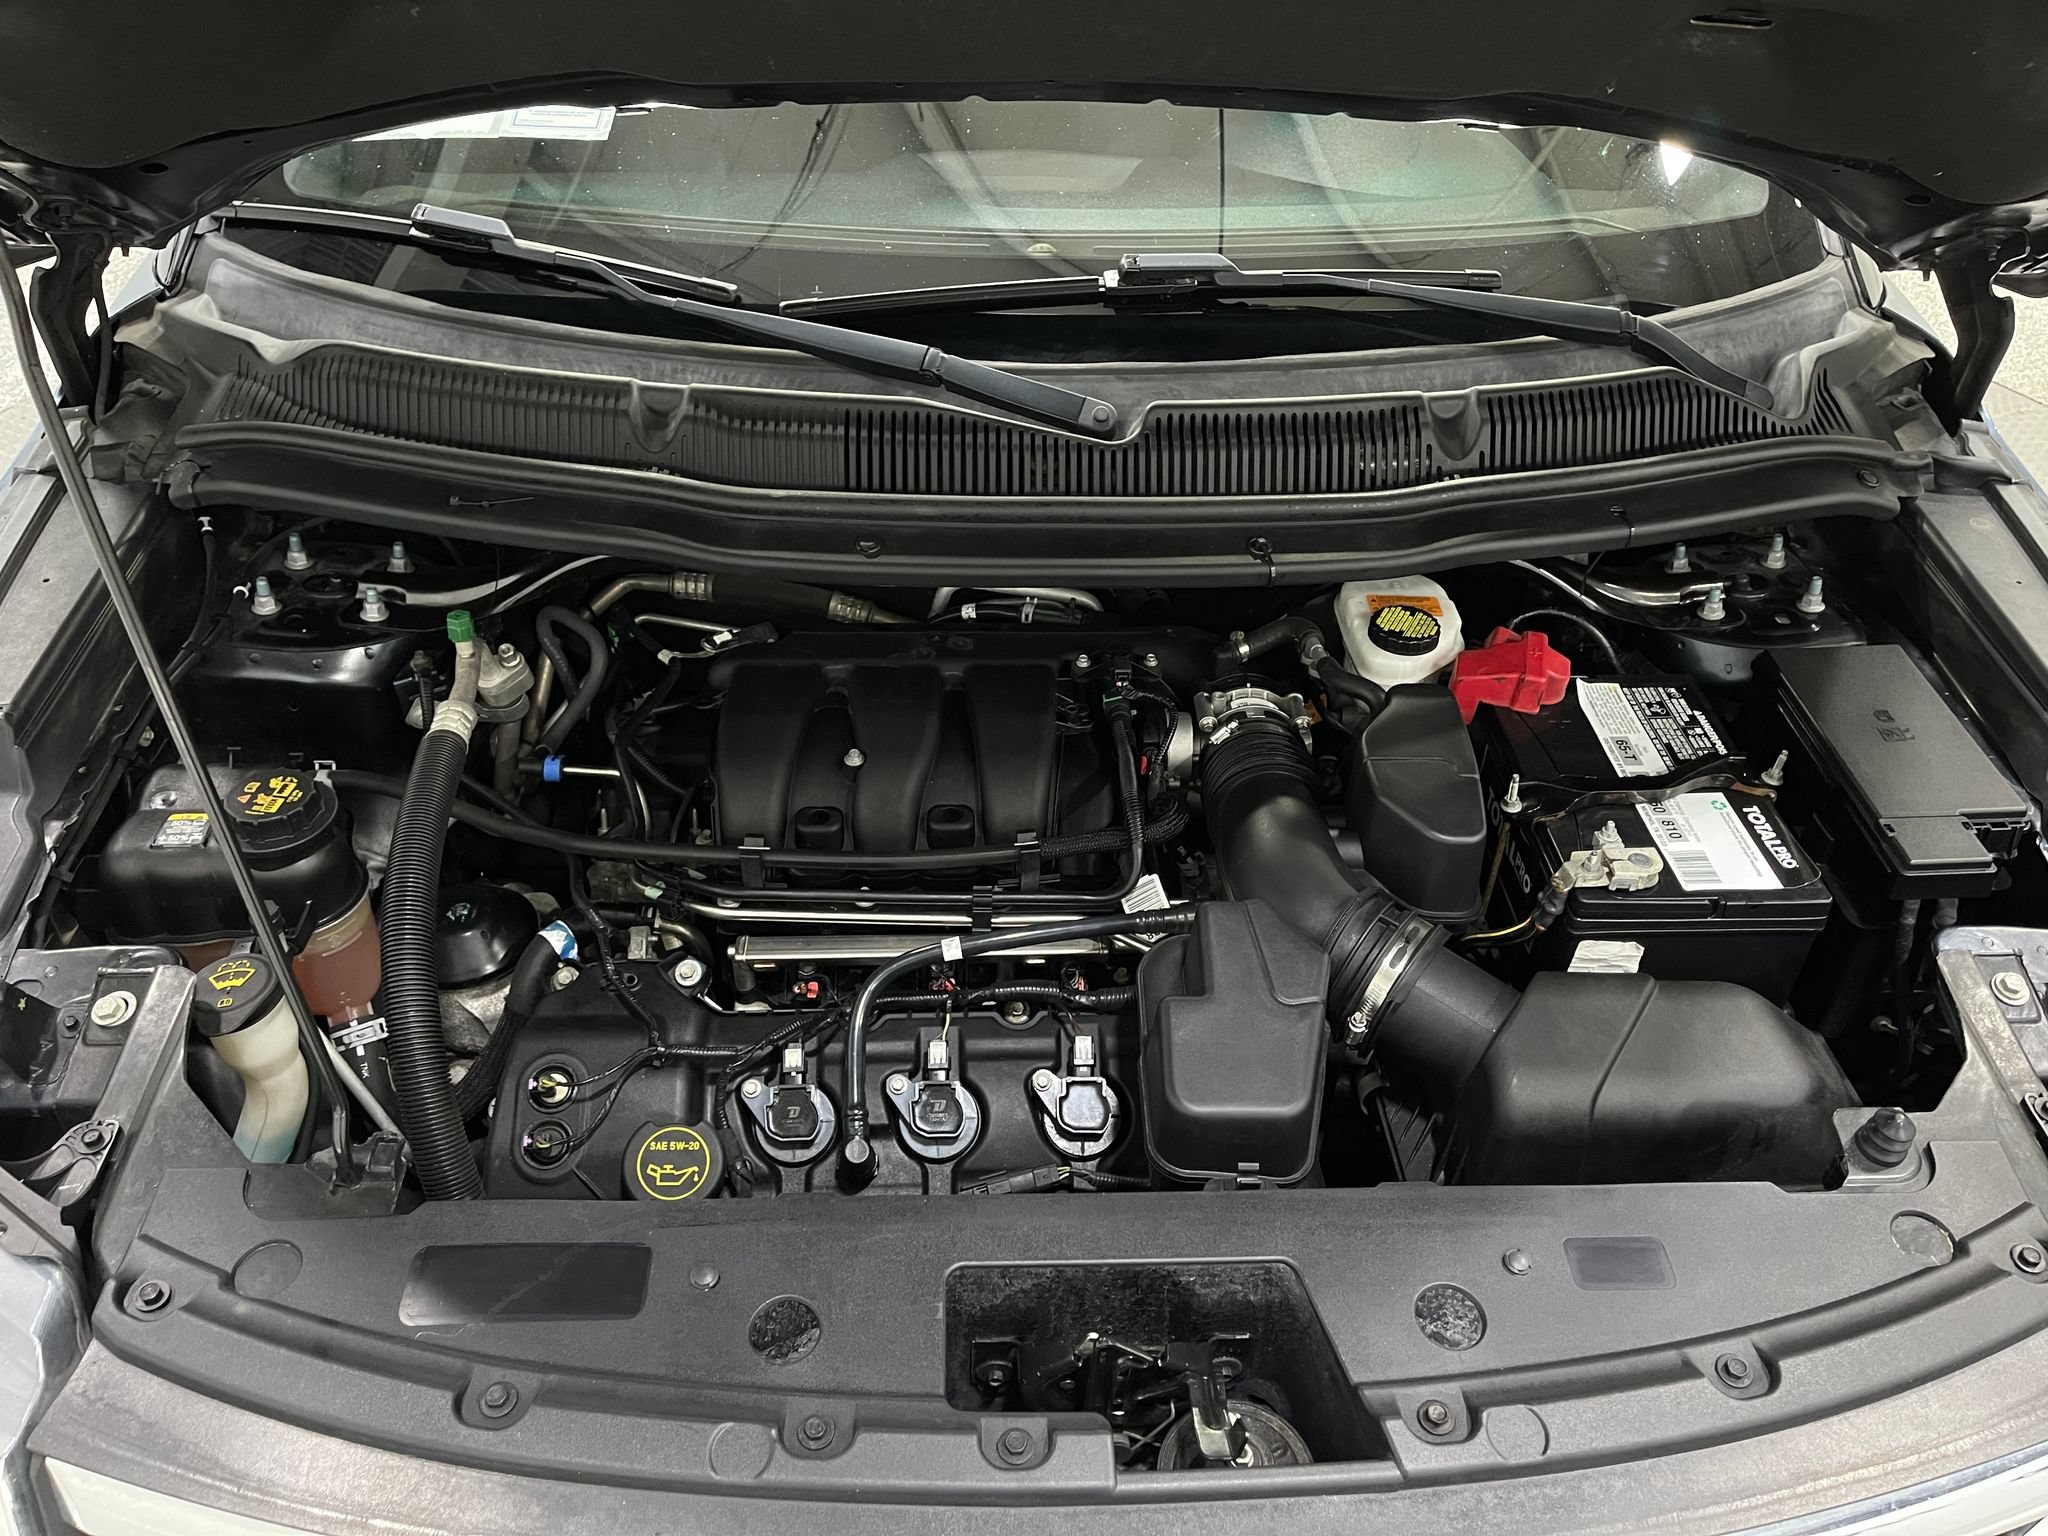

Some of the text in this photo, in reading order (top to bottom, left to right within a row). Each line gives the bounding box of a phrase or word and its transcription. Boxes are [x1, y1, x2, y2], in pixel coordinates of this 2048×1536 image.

[1616, 739, 1638, 761] 65-T
[1661, 820, 1682, 839] 810
[1742, 805, 1799, 869] TOTALPRO
[359, 1062, 371, 1079] TNK
[649, 1141, 700, 1151] SAE 5W-20
